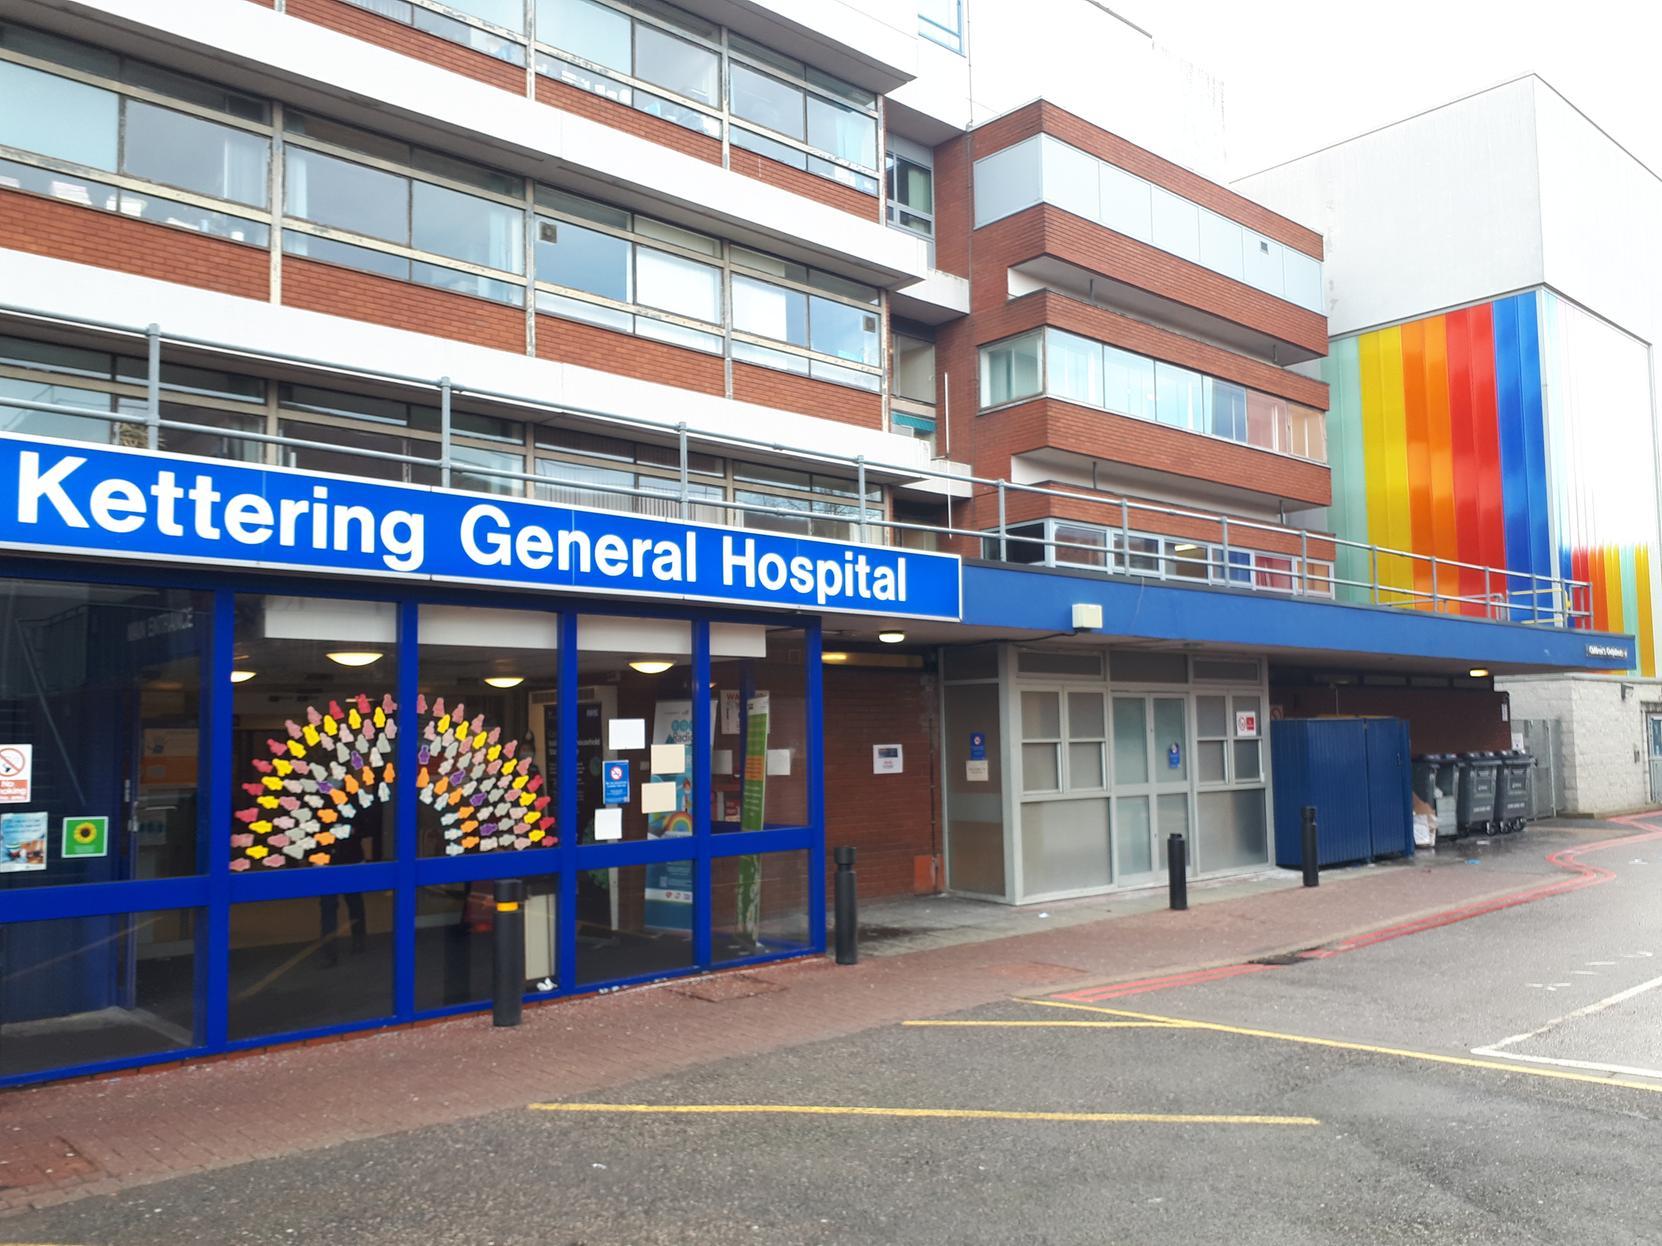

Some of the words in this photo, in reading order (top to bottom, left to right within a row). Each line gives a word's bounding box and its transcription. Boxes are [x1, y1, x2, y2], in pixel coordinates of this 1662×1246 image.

[18, 449, 425, 572] Kettering
[459, 501, 698, 583] General
[721, 532, 908, 606] Hospital
[673, 731, 692, 744] Radi
